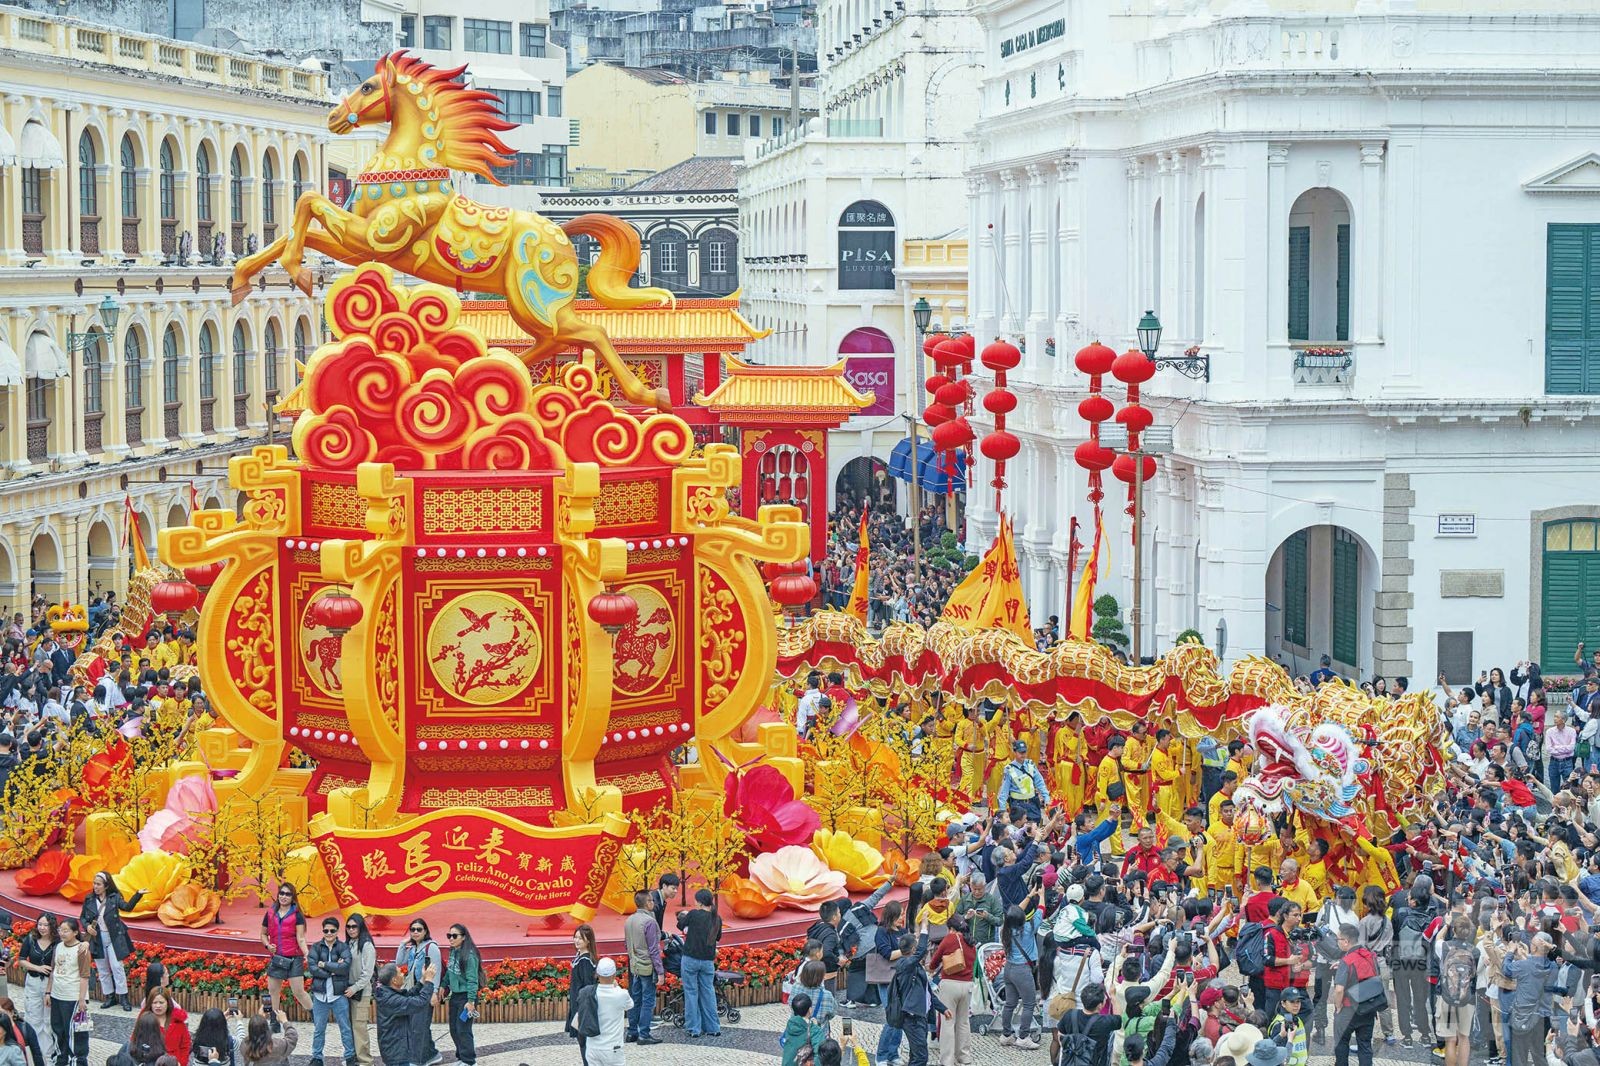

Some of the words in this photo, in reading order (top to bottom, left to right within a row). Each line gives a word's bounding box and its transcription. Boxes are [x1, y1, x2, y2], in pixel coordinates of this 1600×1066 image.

[1015, 33, 1028, 52] CASA
[841, 248, 892, 262] PISA
[455, 874, 499, 887] Celebration
[499, 882, 509, 890] of
[508, 885, 525, 896] Year
[525, 892, 534, 900] of
[535, 892, 548, 901] the
[548, 890, 572, 900] Horse
[456, 861, 484, 873] Feliz
[486, 865, 509, 880] Ano
[509, 875, 524, 887] do
[525, 875, 574, 892] Cavalo
